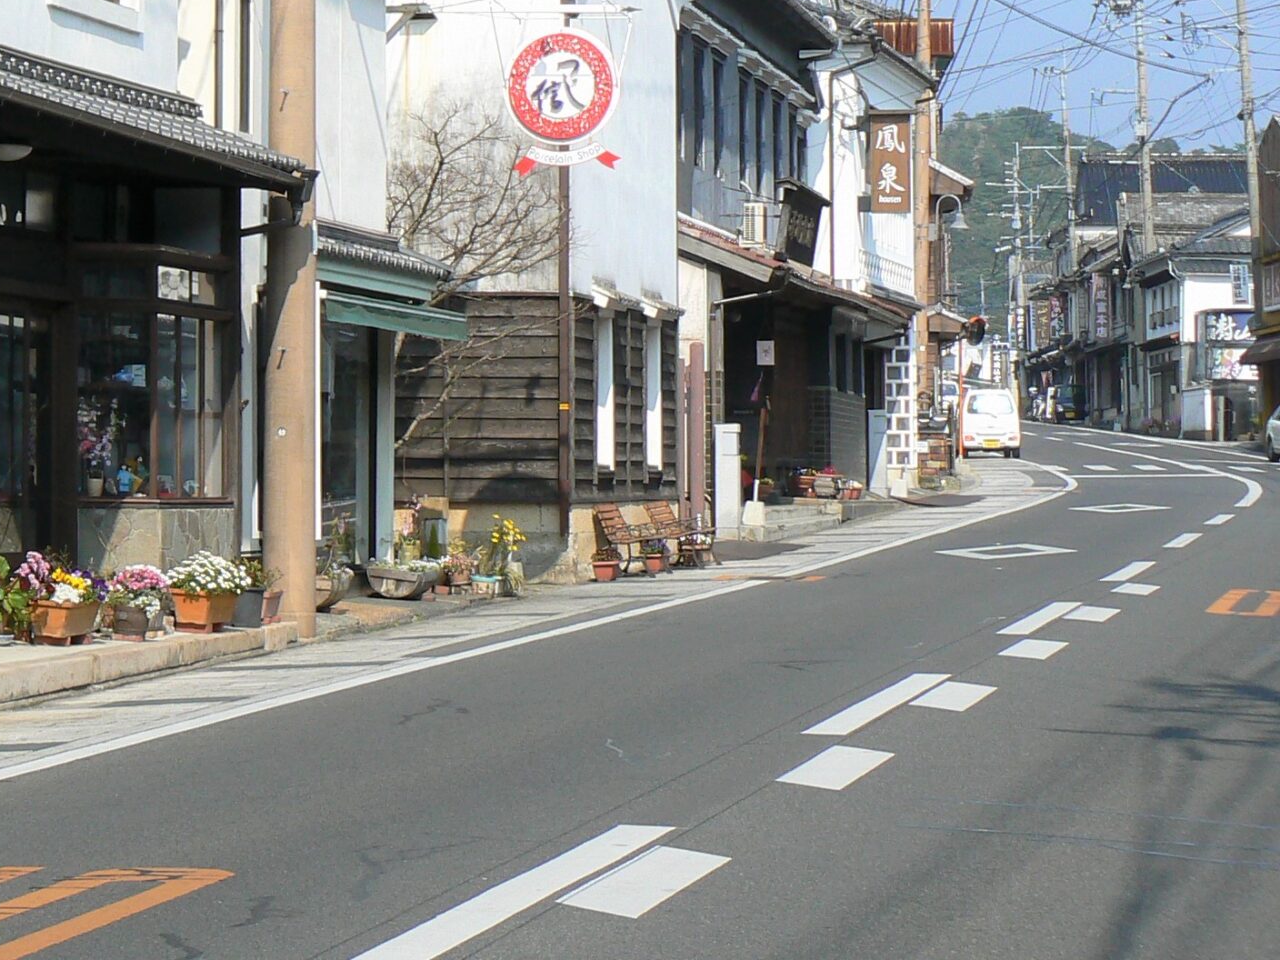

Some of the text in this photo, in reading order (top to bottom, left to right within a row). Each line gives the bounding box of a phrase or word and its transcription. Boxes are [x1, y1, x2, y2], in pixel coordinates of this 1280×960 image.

[528, 145, 601, 164] Porcelain Shop
[875, 124, 906, 194] 鳳泉
